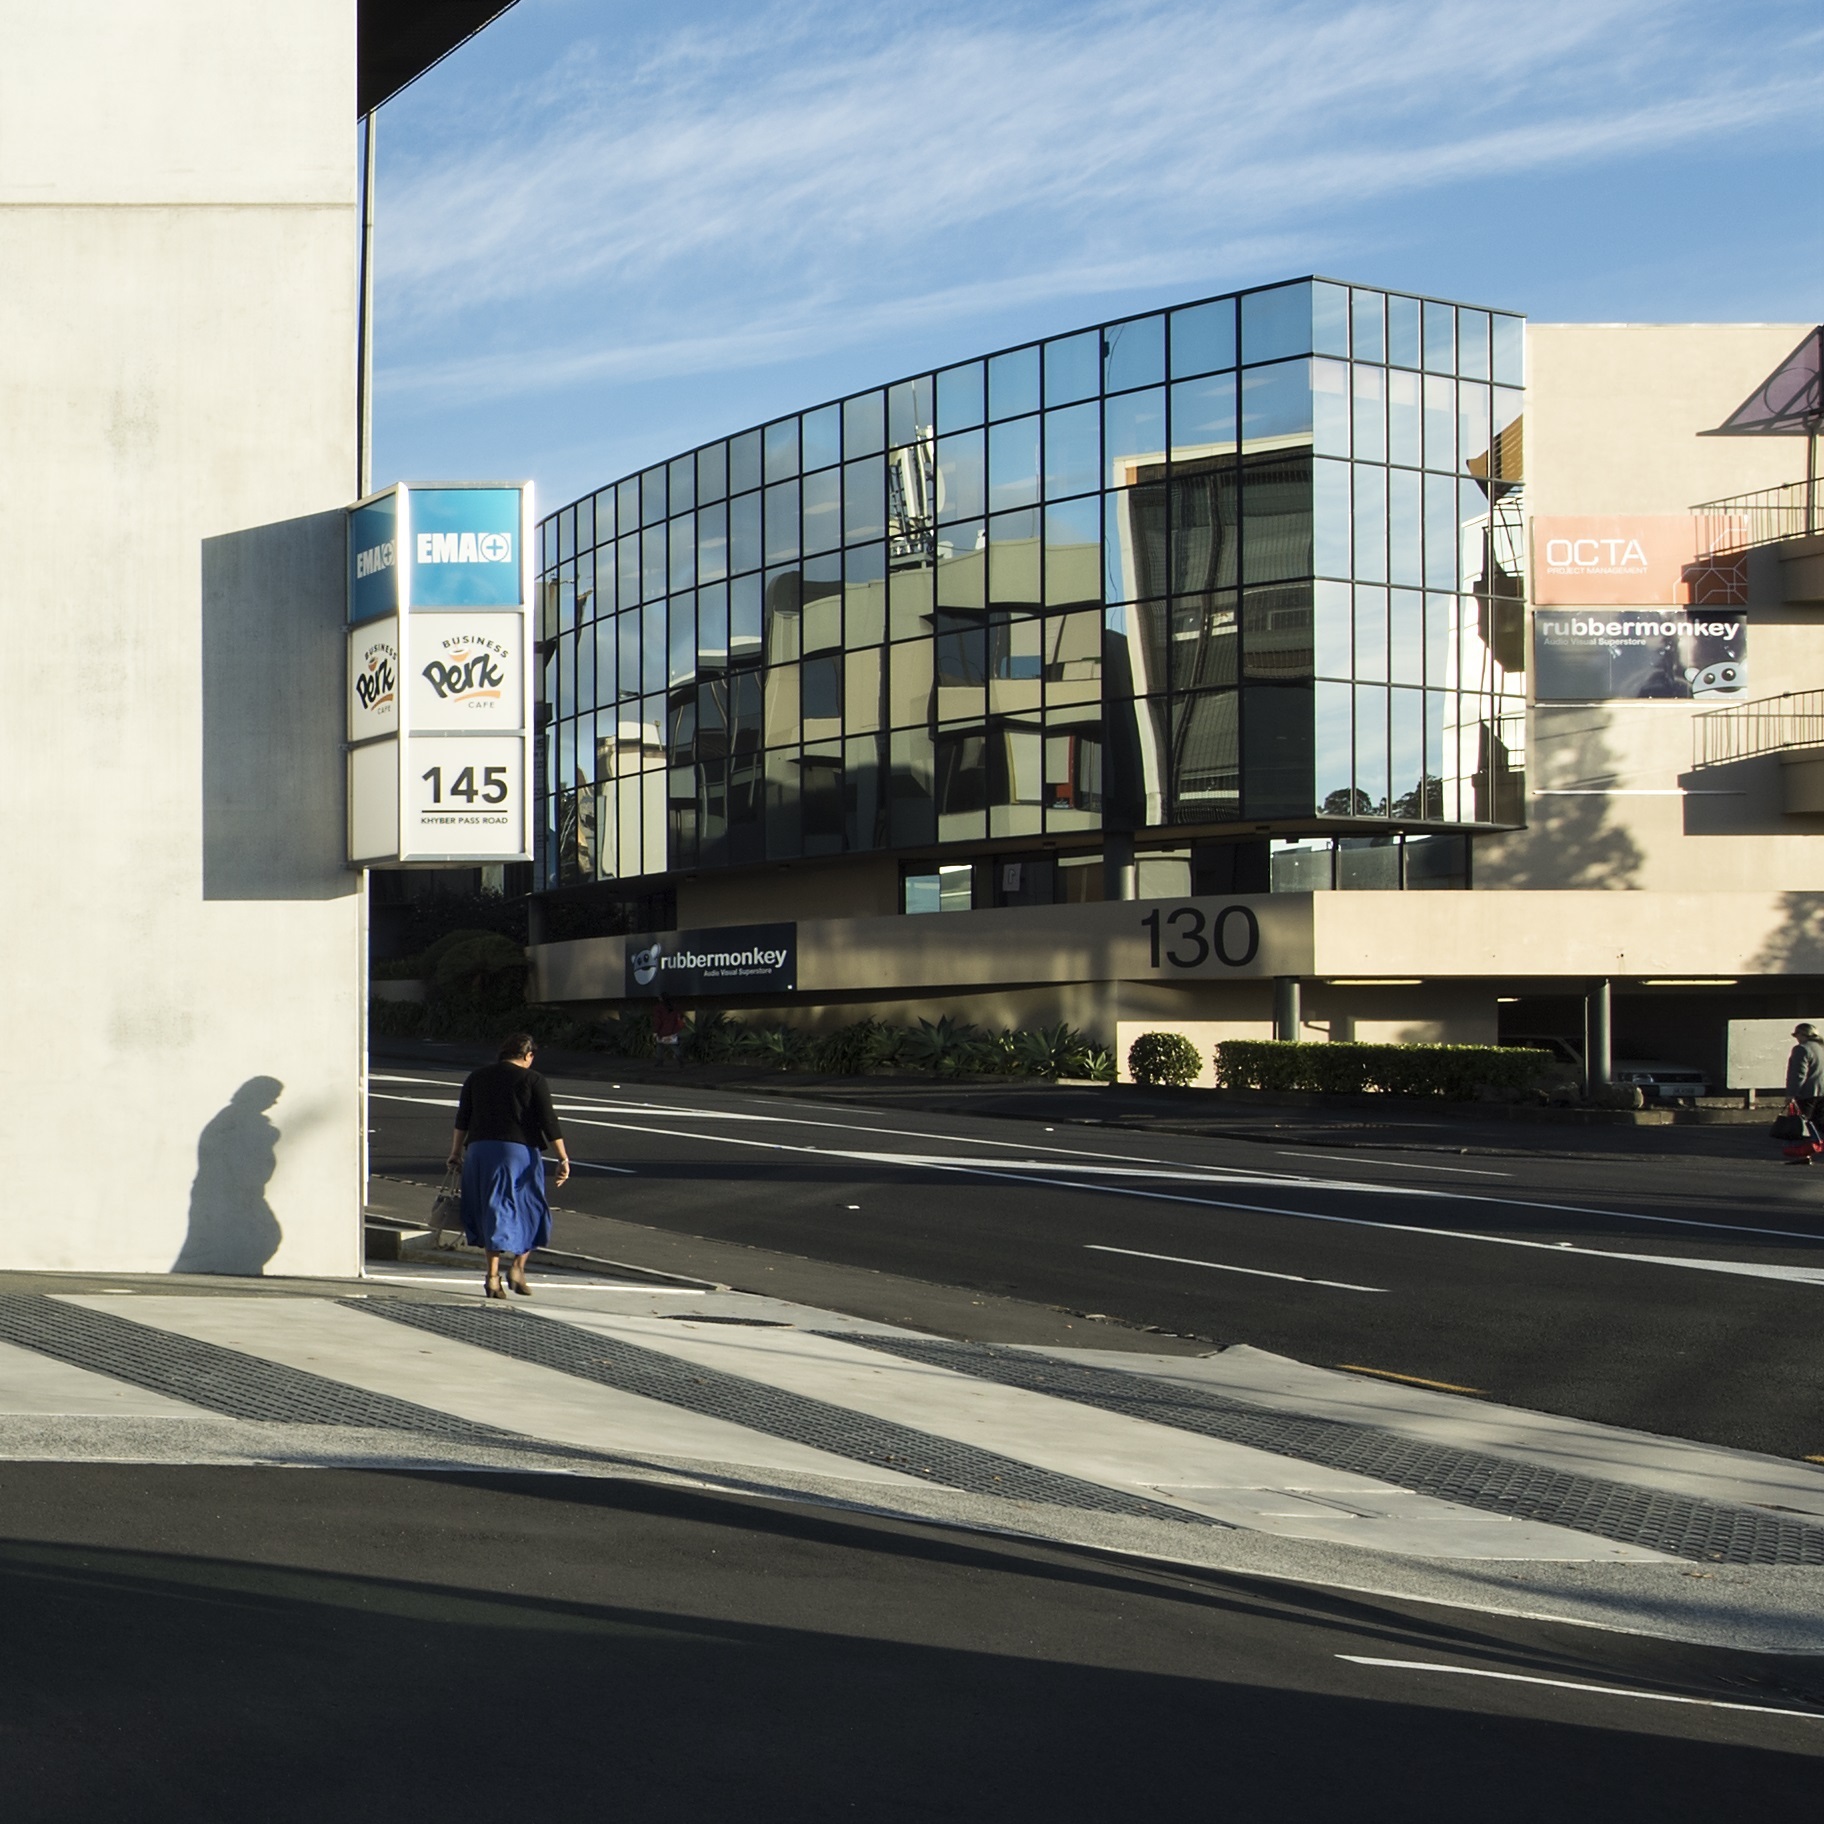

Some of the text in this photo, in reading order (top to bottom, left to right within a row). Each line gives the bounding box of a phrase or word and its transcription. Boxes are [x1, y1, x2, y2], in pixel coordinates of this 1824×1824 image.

[417, 533, 478, 564] EMA
[1546, 539, 1648, 566] OCTA
[357, 547, 382, 579] EMA
[1547, 567, 1648, 575] PROJECT MANAGEMENT
[1542, 618, 1740, 641] rubbermonkey
[364, 643, 398, 661] BUSINESS
[442, 635, 509, 659] BUSINESS
[1544, 638, 1647, 647] Audio Visual Superstore
[356, 658, 395, 710] Perk
[421, 653, 504, 699] Perk
[377, 704, 391, 715] CAFE
[468, 701, 495, 709] CAFE
[421, 766, 508, 804] 145
[1139, 905, 1260, 968] 130
[660, 947, 788, 970] rubbermonkey
[703, 967, 773, 977] Audio Visual Superstore
